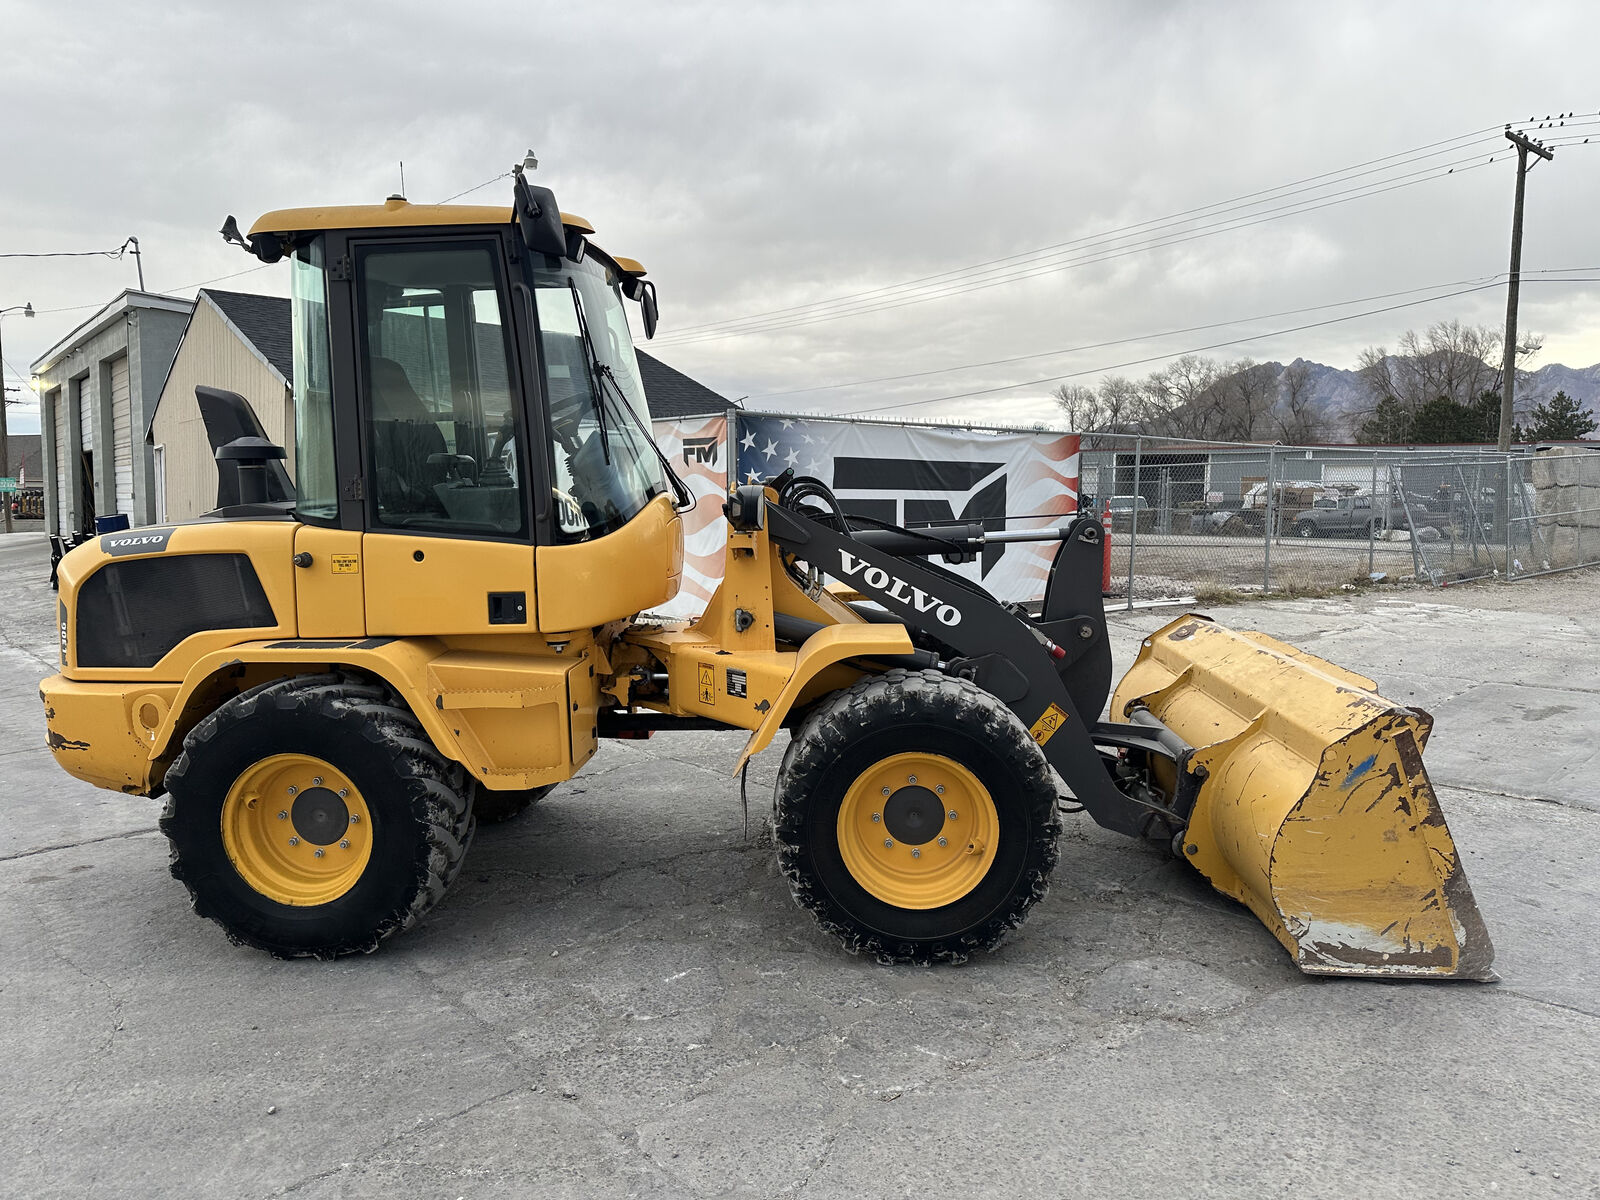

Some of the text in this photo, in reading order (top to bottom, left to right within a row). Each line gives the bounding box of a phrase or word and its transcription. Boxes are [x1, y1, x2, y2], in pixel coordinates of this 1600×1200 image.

[683, 436, 717, 467] FM
[110, 535, 163, 547] VOLVO
[838, 548, 962, 627] VOLVO
